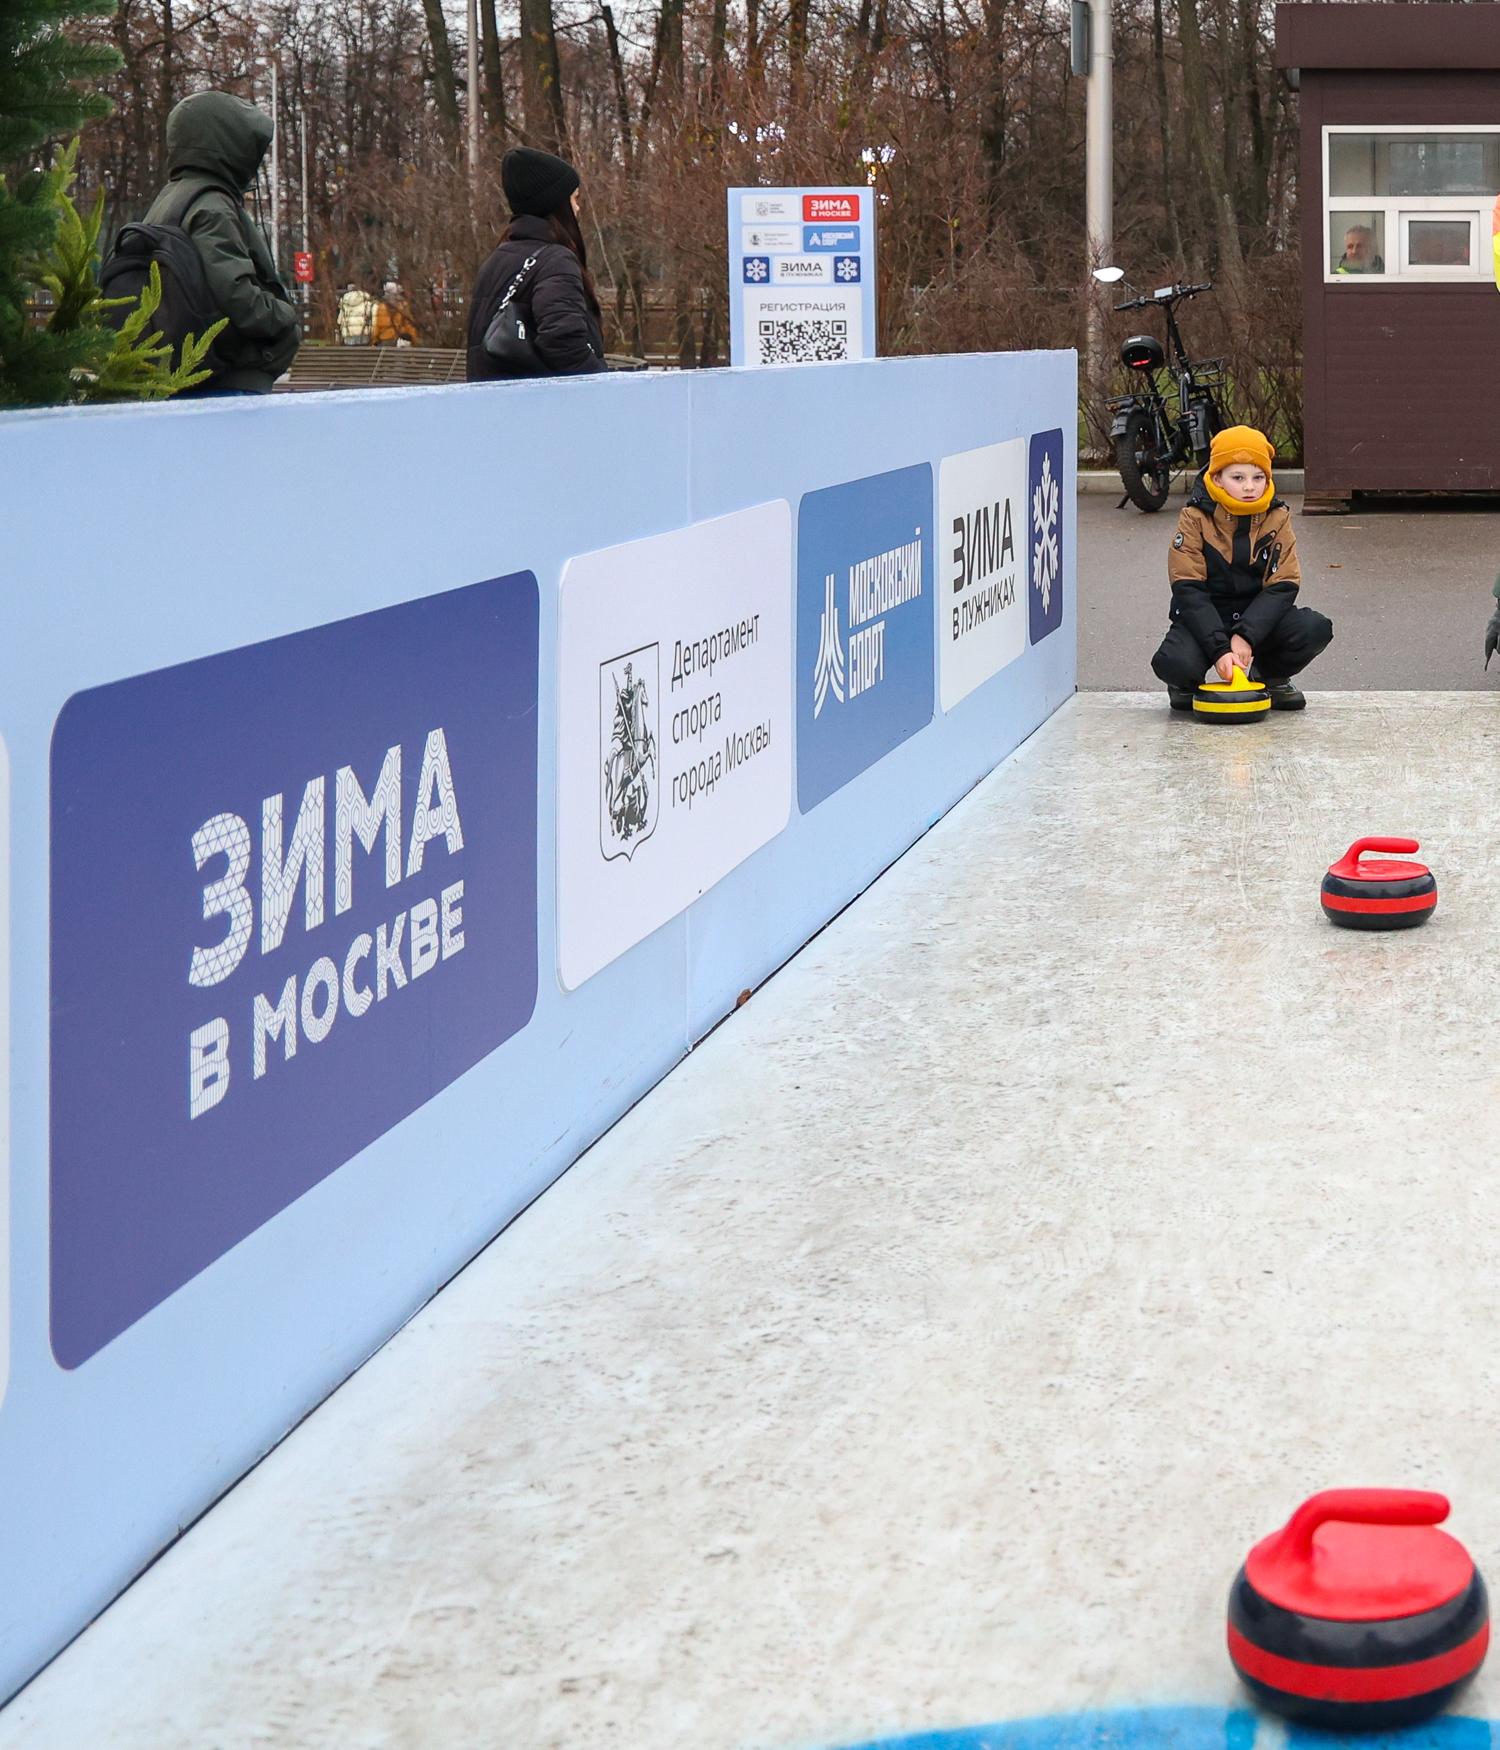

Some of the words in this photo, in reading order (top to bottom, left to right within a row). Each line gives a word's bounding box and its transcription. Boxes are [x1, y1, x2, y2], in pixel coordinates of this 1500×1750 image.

[811, 200, 851, 210] ЗИМА
[781, 263, 822, 271] ЗИМА
[760, 303, 846, 312] РЕГИСТРАЦИЯ
[849, 526, 922, 629] МОСКОВСКИЙ
[953, 498, 1015, 594] ЗИМА
[953, 607, 959, 641] В
[961, 573, 1015, 636] ЛУЖНИКАХ
[671, 614, 760, 693] Департамент
[849, 619, 885, 700] СПОРТ
[672, 691, 722, 749] спорта
[672, 749, 722, 811] города
[725, 719, 771, 773] Москвы
[188, 727, 465, 988] ЗИМА
[190, 1016, 230, 1120] В
[252, 879, 465, 1081] МОСКВЕ
